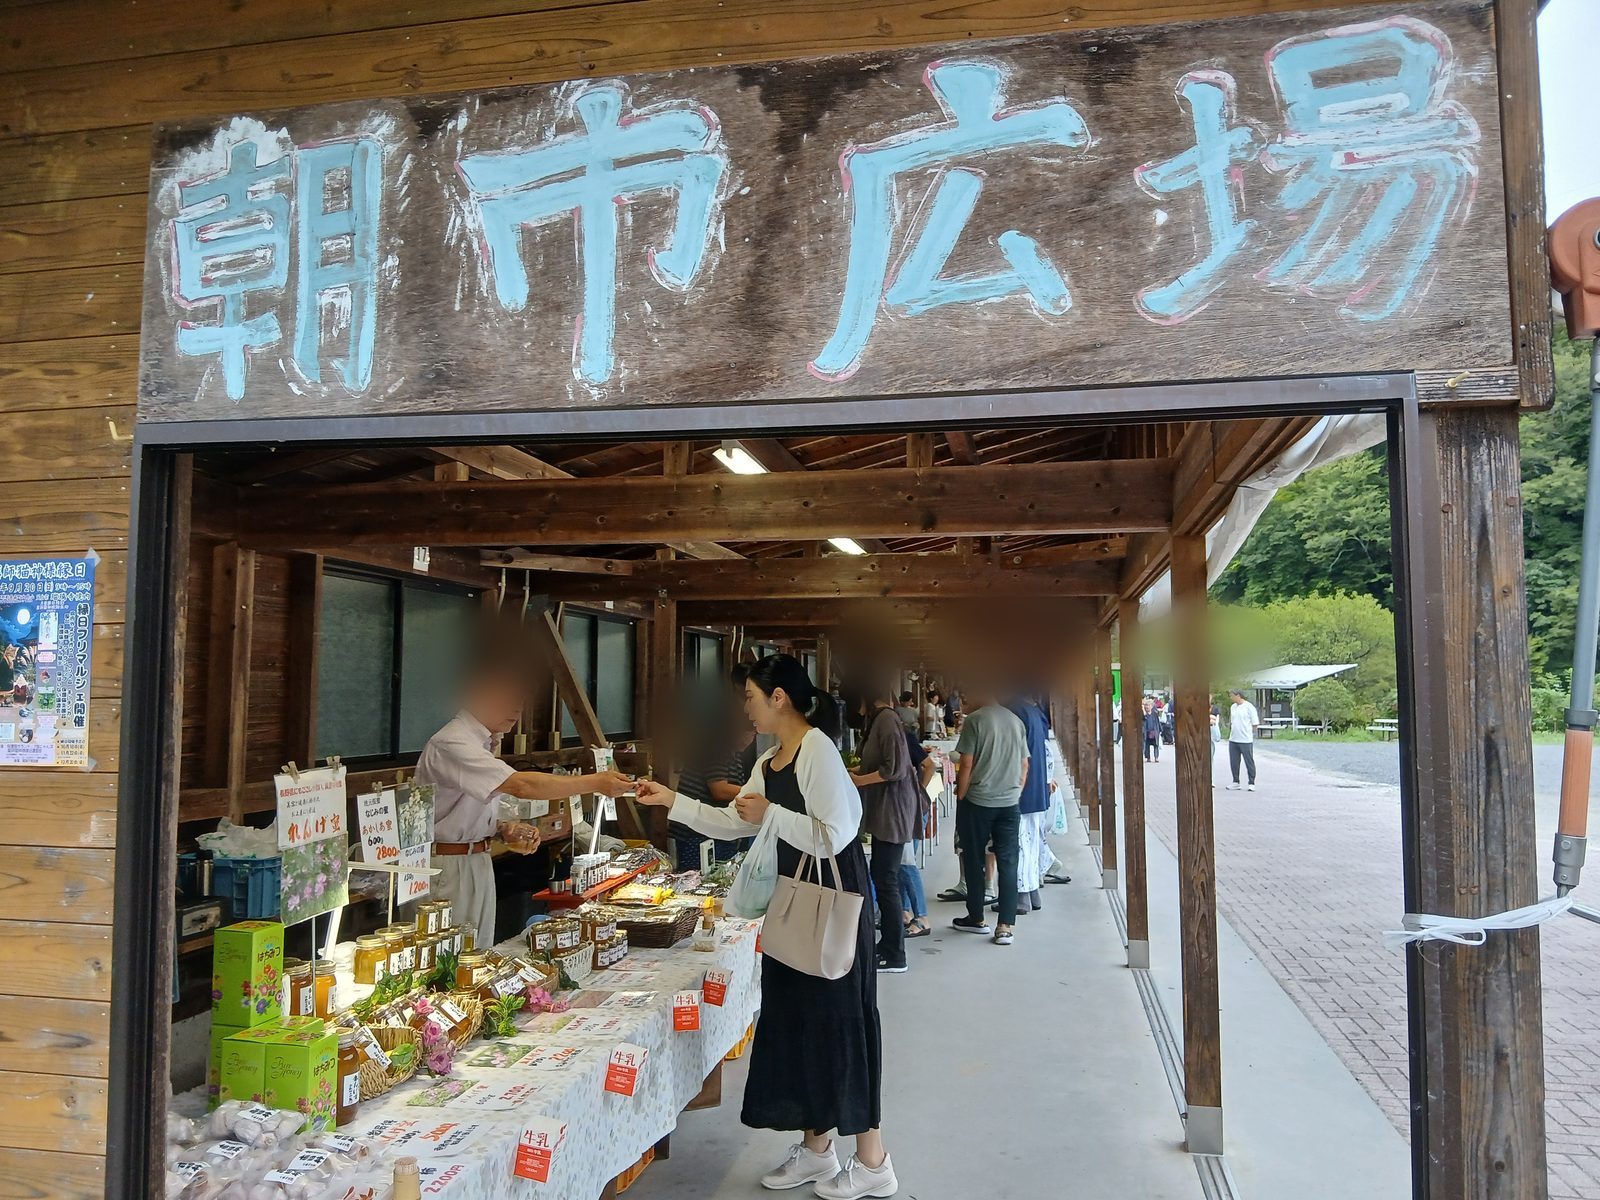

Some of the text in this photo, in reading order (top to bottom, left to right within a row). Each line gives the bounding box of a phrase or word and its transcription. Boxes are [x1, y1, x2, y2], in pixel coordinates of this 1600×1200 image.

[170, 18, 1482, 402] 朝市広場
[0, 562, 87, 581] 師猫神様縁日
[287, 813, 341, 843] れんげ蜜
[362, 819, 393, 836] あかしあ蜜
[257, 946, 281, 962] はちみつ
[707, 971, 726, 985] 牛乳
[676, 993, 697, 1006] 牛乳
[313, 1057, 336, 1077] はちみつ
[614, 1050, 636, 1067] 牛乳
[271, 1067, 303, 1079] Honey
[524, 1129, 550, 1148] 牛乳
